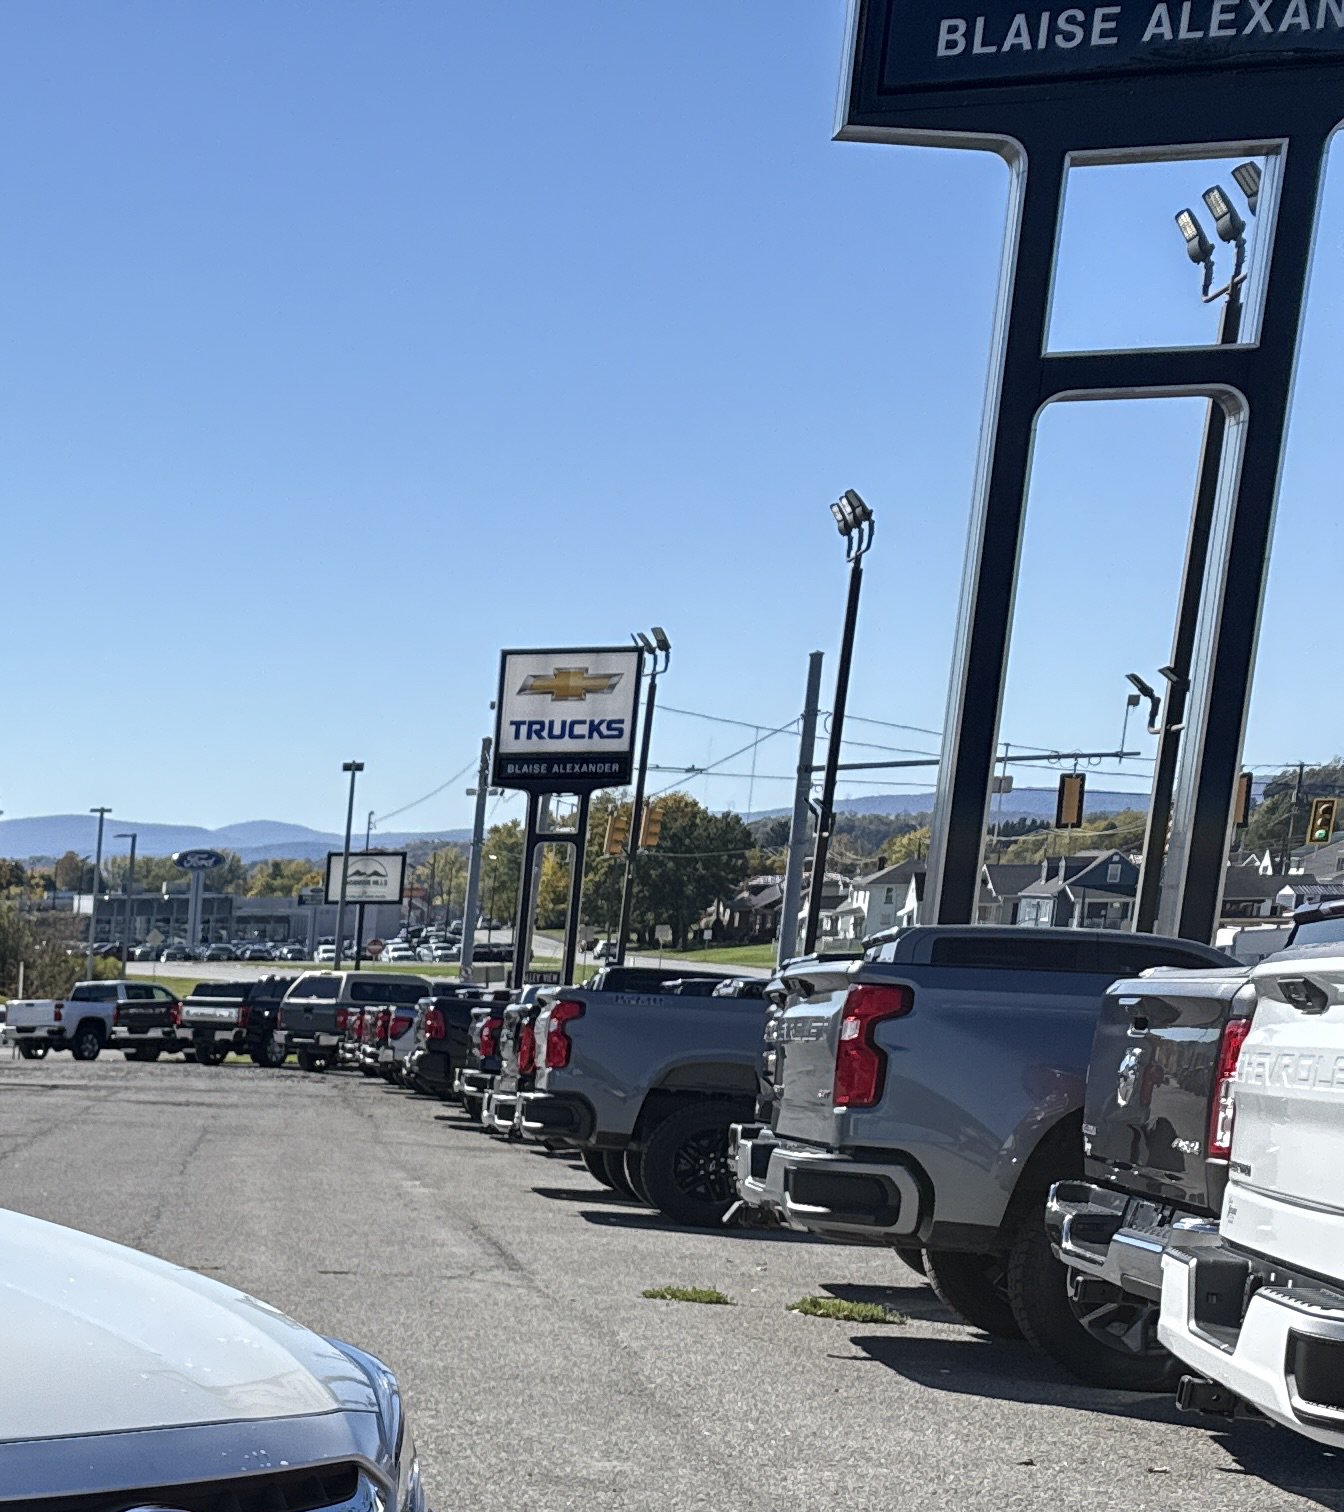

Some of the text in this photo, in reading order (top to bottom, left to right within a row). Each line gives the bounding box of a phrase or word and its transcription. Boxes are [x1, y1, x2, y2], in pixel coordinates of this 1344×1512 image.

[936, 5, 1121, 57] BLAISE
[509, 718, 625, 740] TRUCKS
[506, 762, 620, 774] BLAISE ALEXANDER
